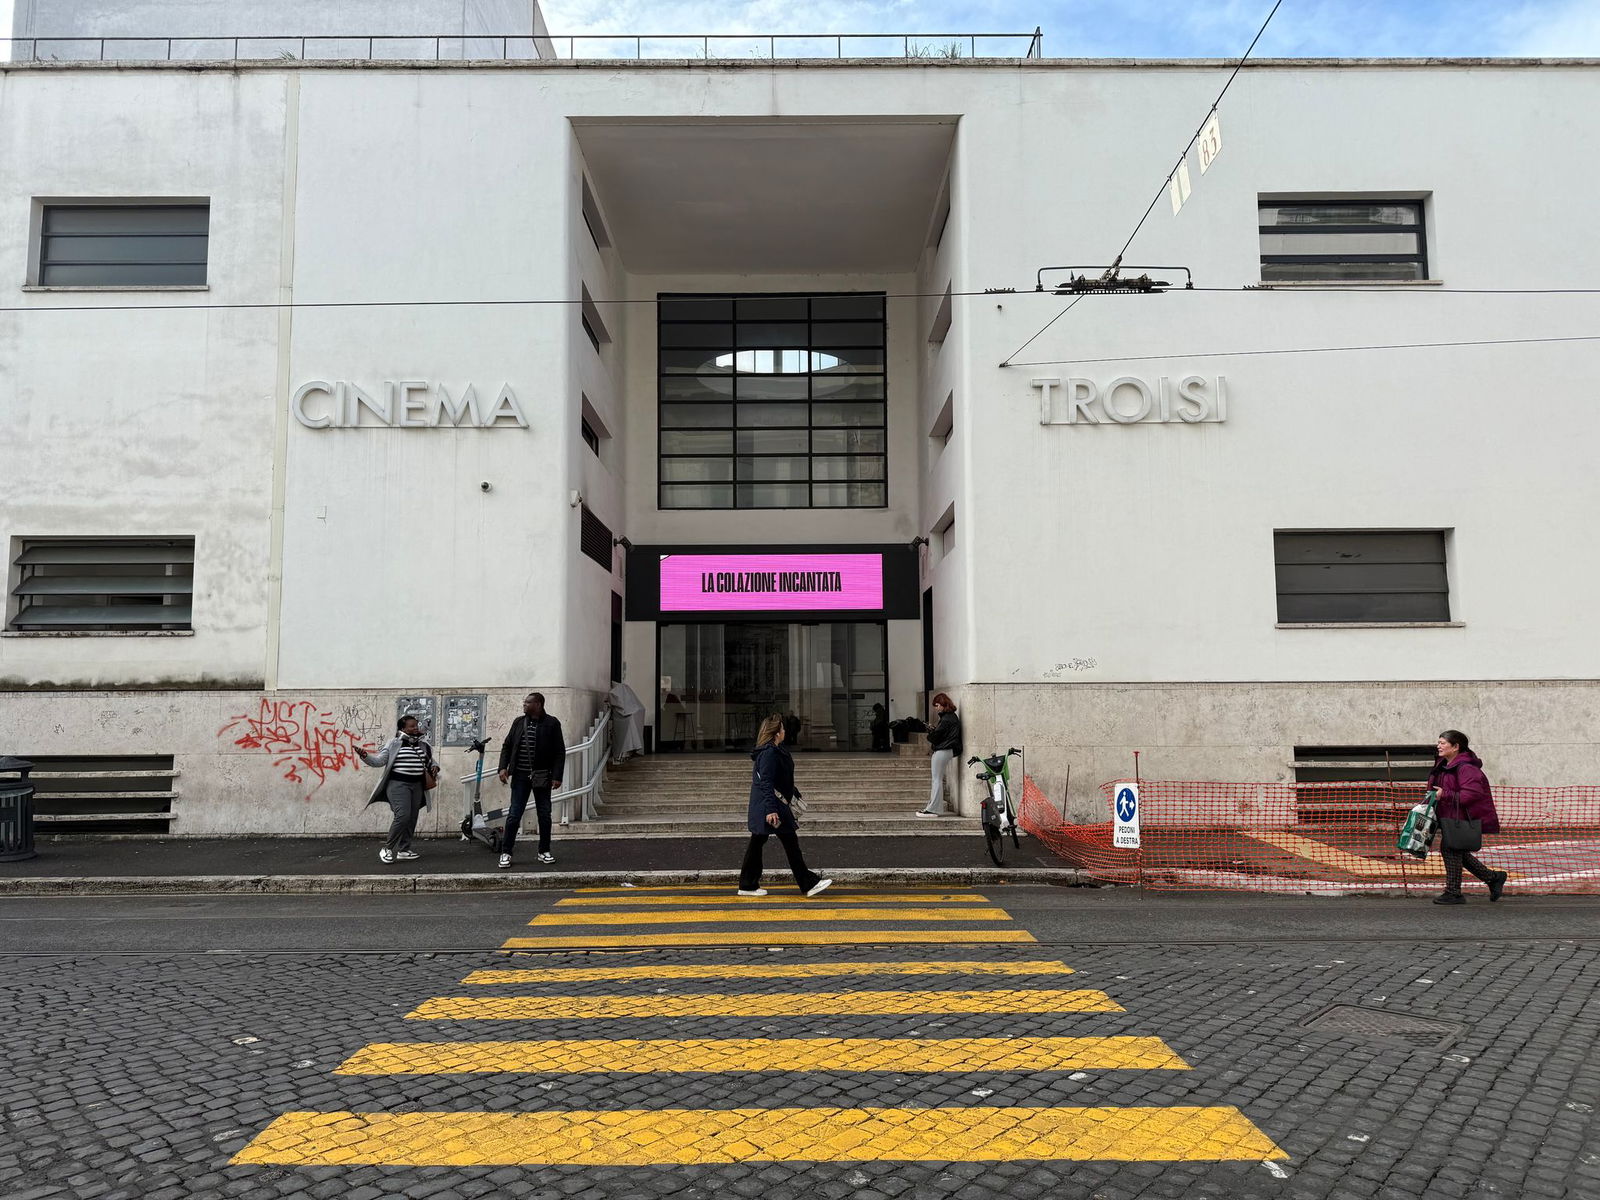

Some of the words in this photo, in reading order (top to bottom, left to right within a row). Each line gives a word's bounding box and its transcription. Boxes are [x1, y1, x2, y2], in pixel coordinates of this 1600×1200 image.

[292, 380, 529, 429] CINEMA
[1031, 376, 1226, 425] TROISI
[701, 572, 715, 593] LA
[716, 572, 777, 593] COLAZIONE
[779, 571, 842, 592] INCANTATA
